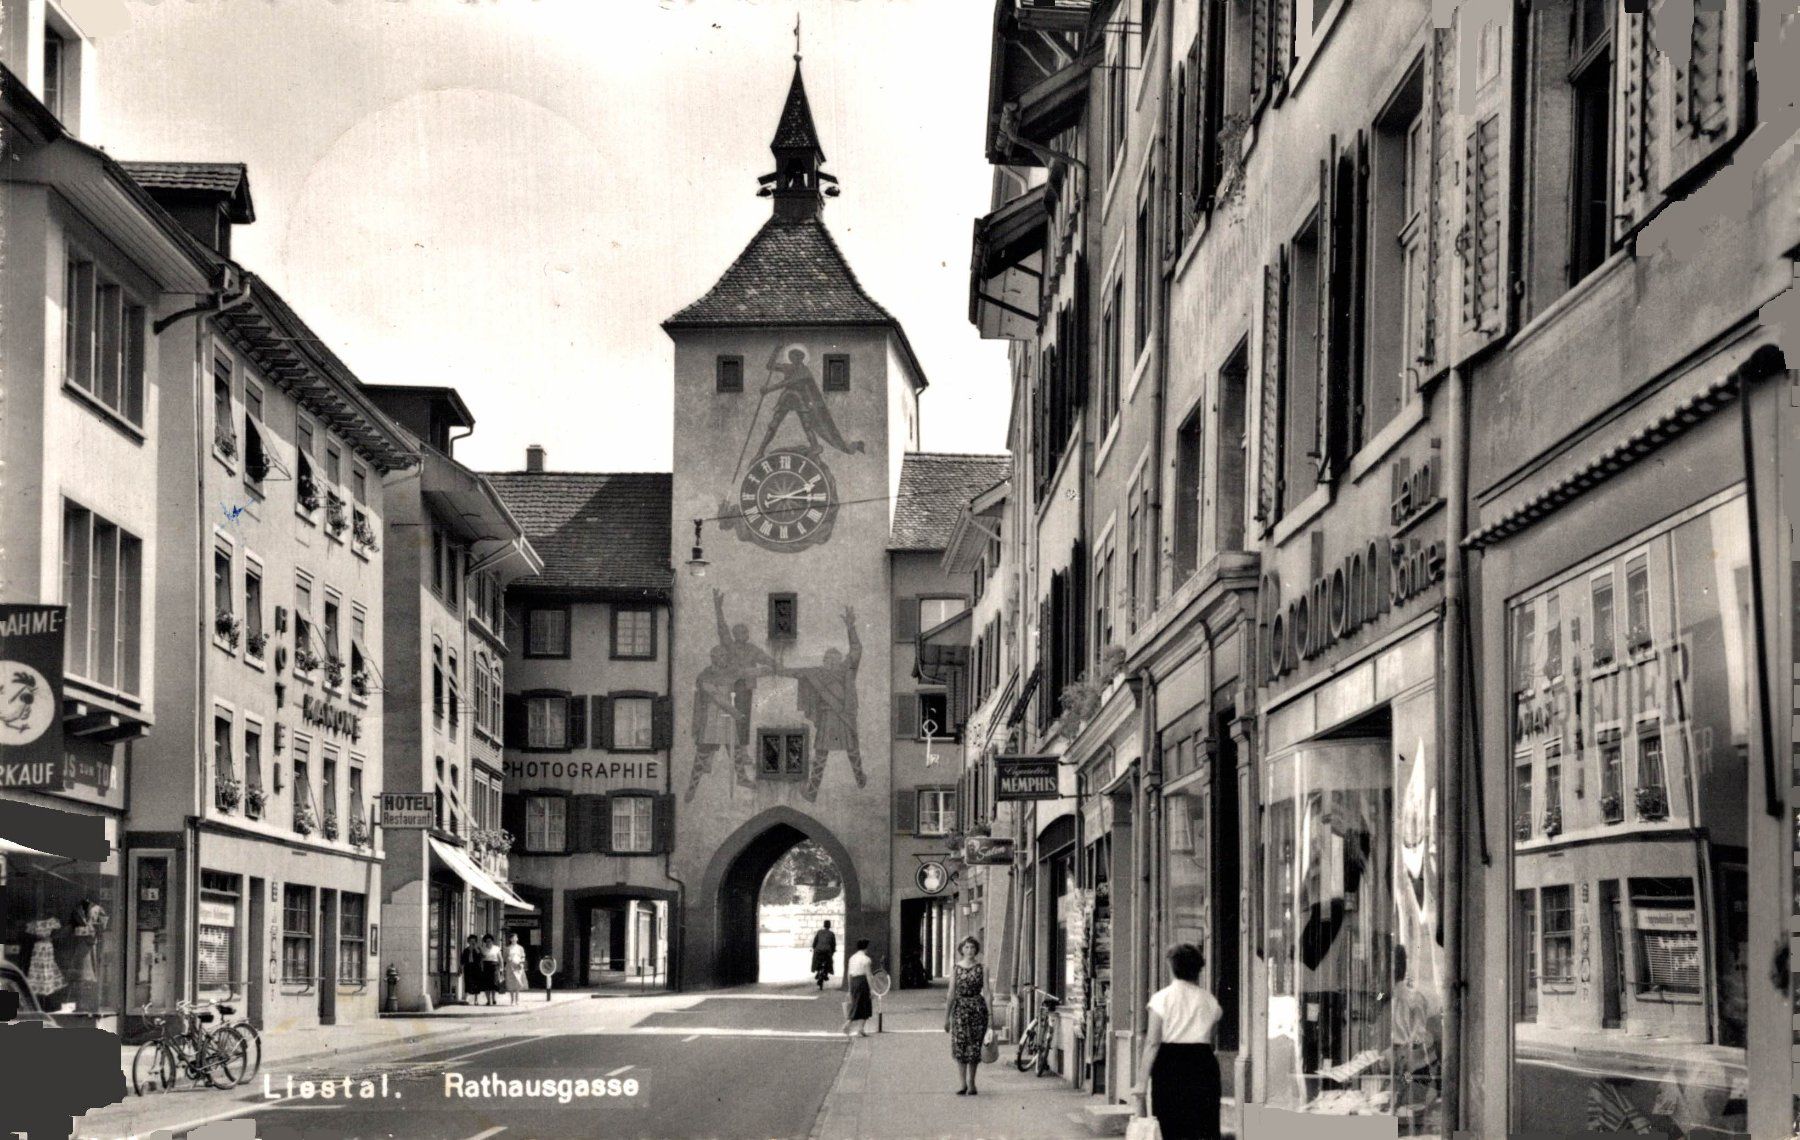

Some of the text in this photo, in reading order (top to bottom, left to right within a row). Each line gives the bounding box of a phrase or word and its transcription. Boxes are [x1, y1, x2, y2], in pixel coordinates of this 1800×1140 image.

[1390, 438, 1441, 527] Henri
[274, 605, 288, 796] HOTEL
[502, 761, 658, 779] PHOTOGRAPHIE
[1001, 776, 1057, 793] MEMPHIS
[384, 795, 432, 811] HOTEL
[383, 811, 430, 825] Restaurant
